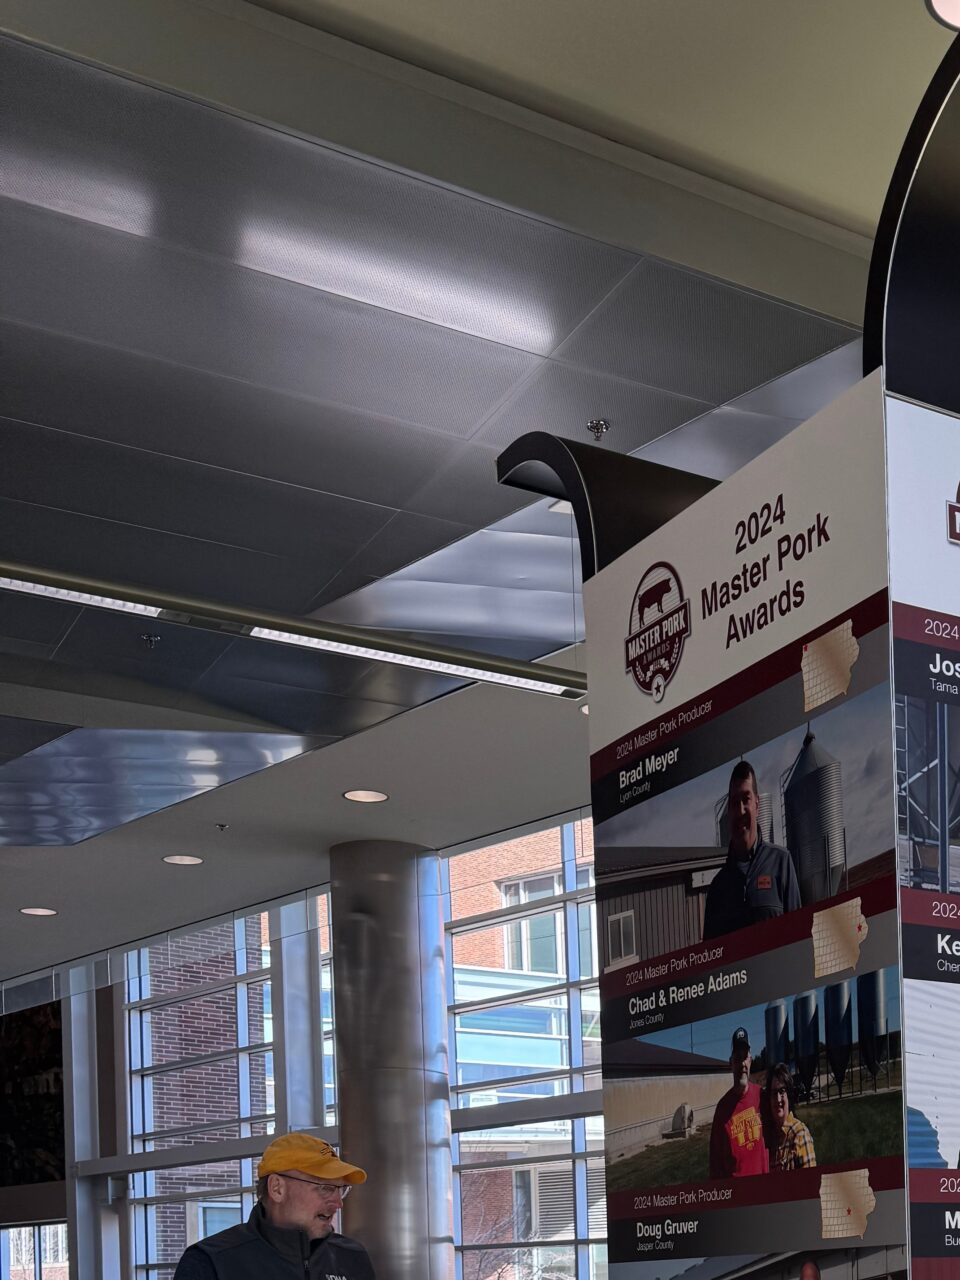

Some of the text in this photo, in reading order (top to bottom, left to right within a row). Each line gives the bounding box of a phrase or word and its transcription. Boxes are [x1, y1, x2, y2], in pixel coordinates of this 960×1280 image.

[735, 493, 786, 554] 2024
[701, 513, 830, 620] Master Pork
[628, 609, 685, 661] MASTER PORK
[726, 579, 805, 649] Awards
[924, 619, 959, 639] 2024
[930, 678, 958, 692] Tama
[616, 700, 712, 759] 2024 Master Pork Producer
[620, 747, 679, 788] Brad Meyer
[626, 946, 723, 986] 2024 Master Pork Producer
[629, 969, 747, 1014] Chad & Renee Adams
[634, 1188, 732, 1209] 2024 Master Pork Producer
[636, 1219, 698, 1239] Doug Gruver
